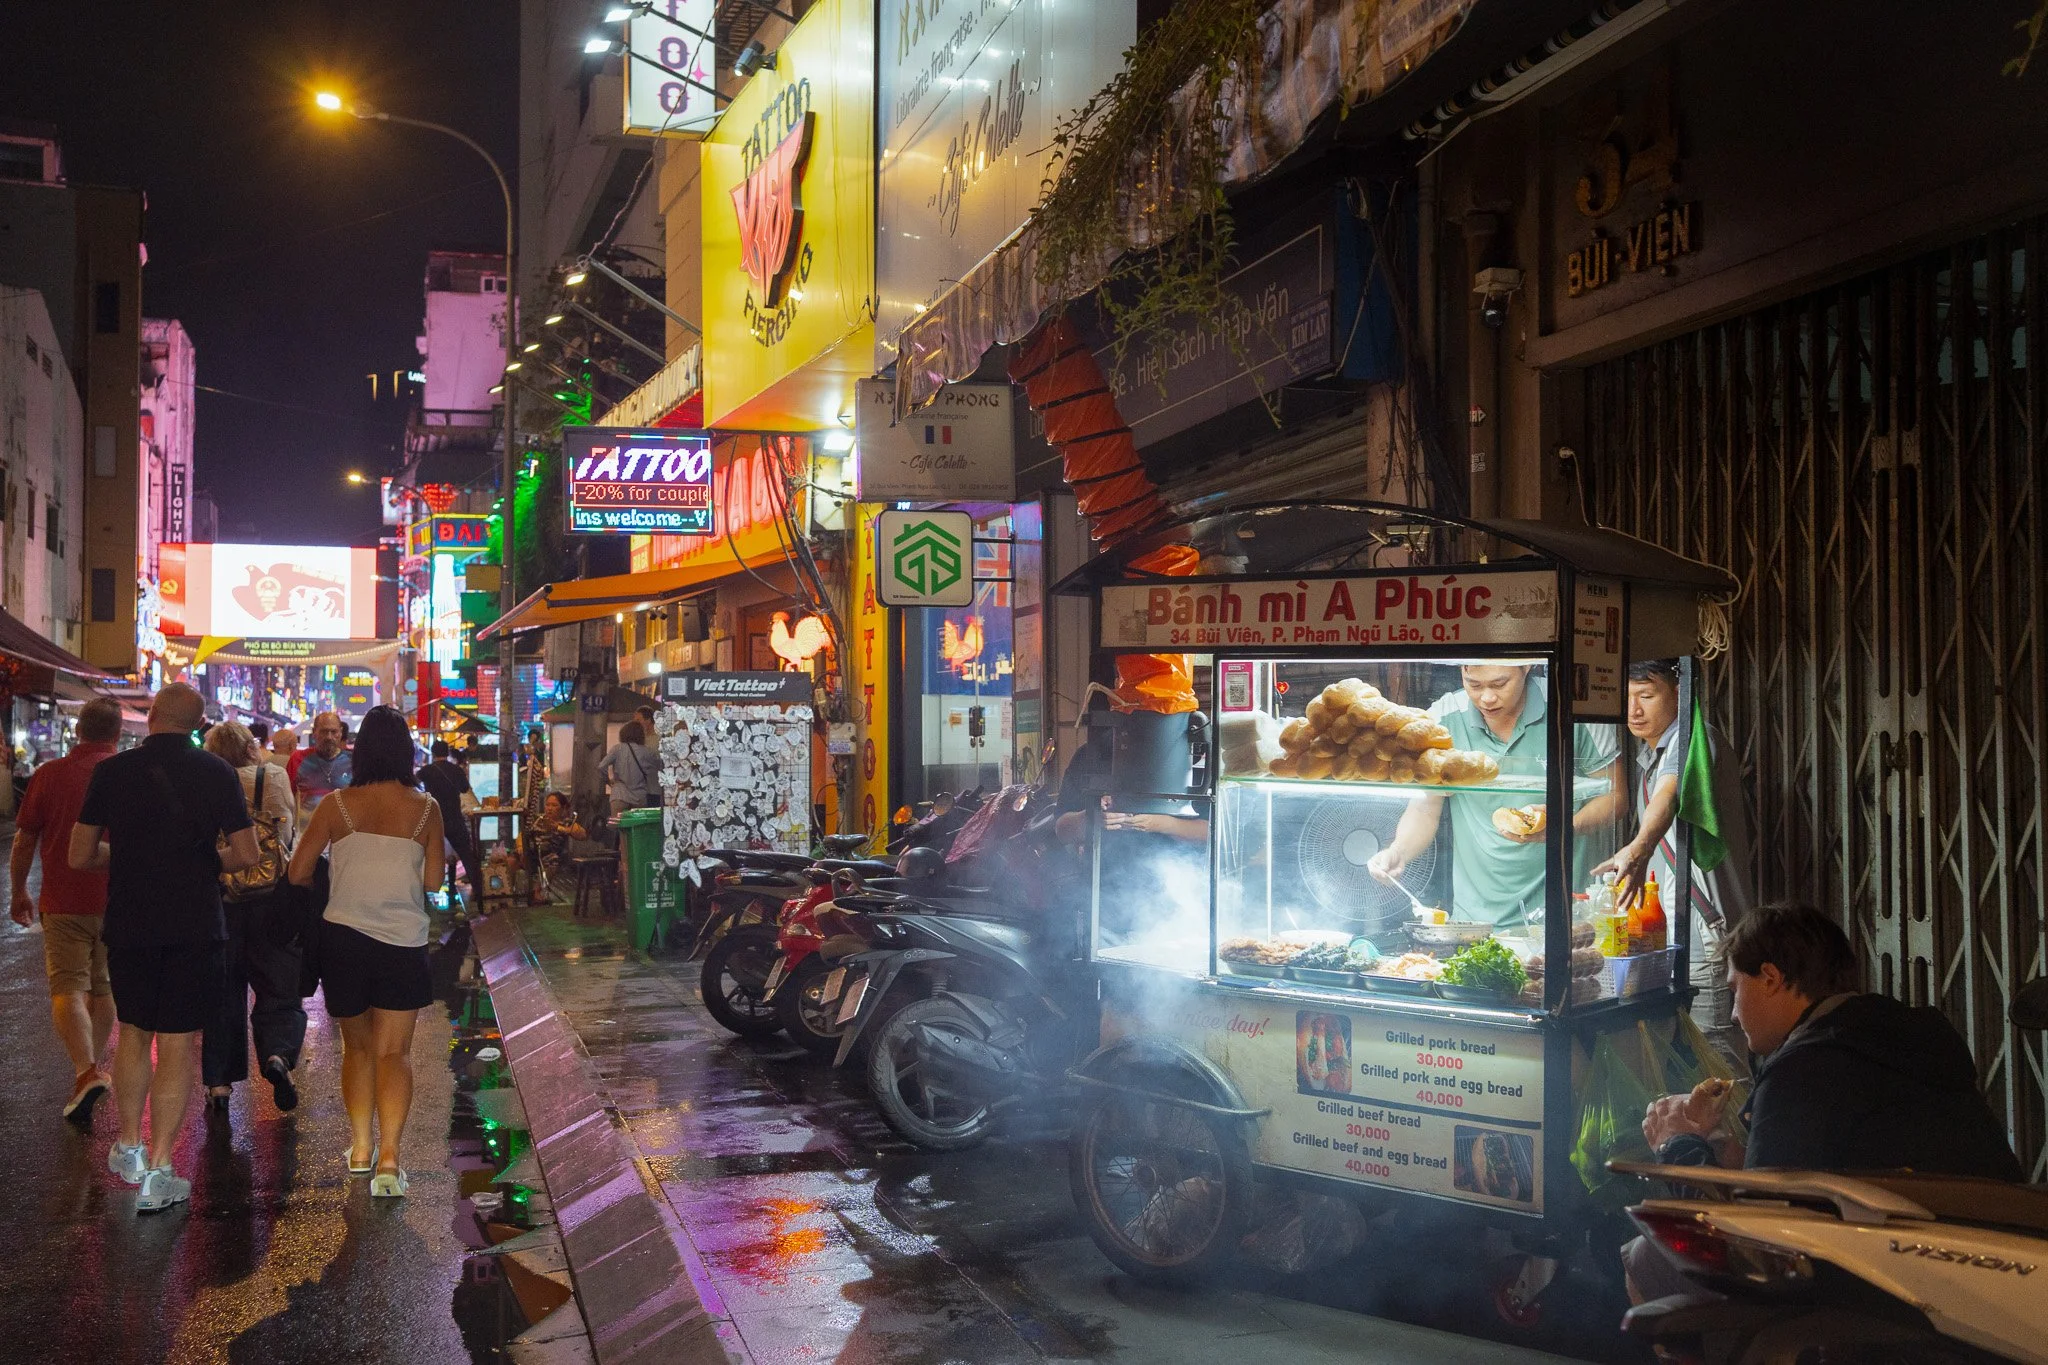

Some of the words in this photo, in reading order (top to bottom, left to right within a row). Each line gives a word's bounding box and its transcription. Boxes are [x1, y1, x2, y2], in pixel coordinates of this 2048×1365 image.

[896, 67, 931, 129] Librairie
[741, 77, 812, 182] TATTOO
[972, 57, 1026, 184] Colette
[1172, 326, 1206, 371] Sách
[1256, 281, 1289, 326] Văn
[944, 391, 999, 407] PHONG
[575, 446, 711, 482] TATTOO
[909, 454, 933, 474] Café
[934, 454, 968, 470] Colette
[628, 486, 652, 500] for
[576, 508, 603, 525] ins
[1147, 584, 1242, 626] Bánh
[1258, 582, 1309, 622] mì
[1323, 580, 1357, 621] A
[1375, 574, 1492, 620] Phúc
[1586, 583, 1609, 596] MENU
[1170, 630, 1191, 644] 34
[1196, 629, 1220, 643] Bùi
[1272, 627, 1287, 643] P.
[1347, 624, 1381, 645] Ngũ
[1387, 625, 1425, 641] Lão,
[1431, 624, 1461, 639] Q.1
[862, 519, 877, 836] TATTOO
[585, 696, 603, 707] 40
[1183, 1011, 1222, 1030] nice
[1227, 1014, 1270, 1039] day!
[1385, 1030, 1424, 1047] Grilled
[1428, 1034, 1456, 1052] pork
[1460, 1037, 1496, 1056] bread
[1416, 1052, 1463, 1070] 30,000
[1361, 1062, 1398, 1080] Grilled
[1402, 1067, 1429, 1084] pork
[1433, 1072, 1456, 1088] and
[1460, 1080, 1483, 1096] egg
[1487, 1080, 1523, 1098] bread
[1416, 1089, 1463, 1107] 40,000
[1317, 1100, 1354, 1118] Grilled
[1357, 1104, 1384, 1122] beef
[1388, 1108, 1421, 1128] bread
[1345, 1123, 1390, 1142] 30,000
[1292, 1131, 1329, 1150] Grilled
[1332, 1137, 1358, 1154] beef
[1362, 1142, 1383, 1159] and
[1387, 1150, 1409, 1166] egg
[1413, 1149, 1448, 1170] bread
[1345, 1158, 1390, 1178] 40,000
[1889, 1239, 2039, 1276] VISION
